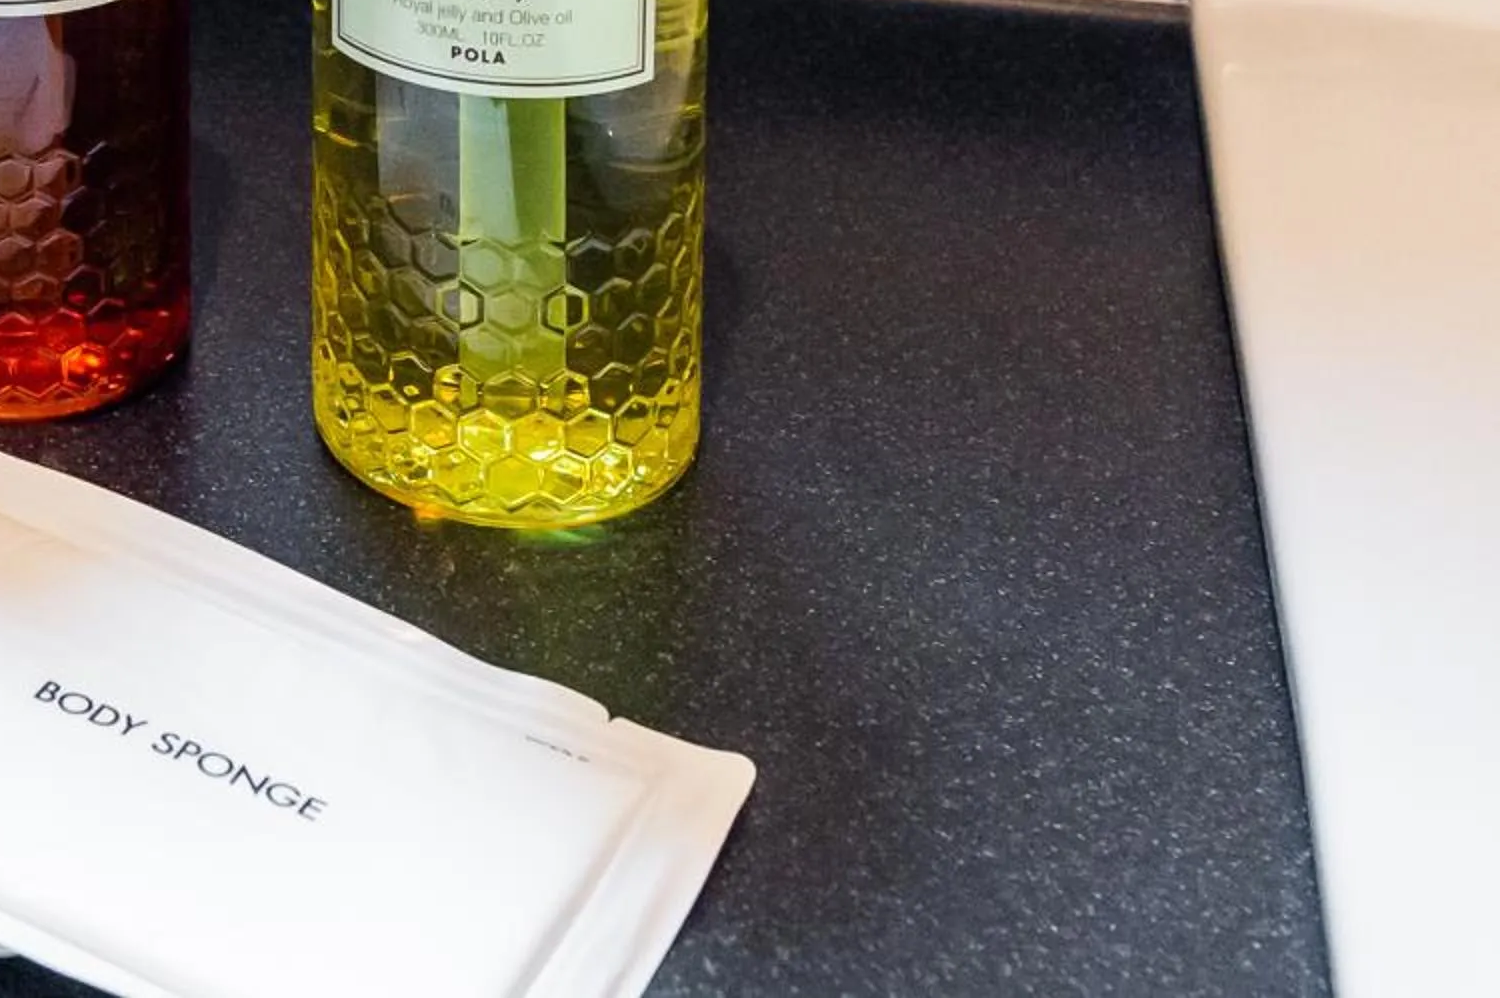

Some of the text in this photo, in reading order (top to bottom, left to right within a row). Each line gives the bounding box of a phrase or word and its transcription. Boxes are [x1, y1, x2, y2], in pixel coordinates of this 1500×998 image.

[436, 0, 467, 24] jelly
[471, 5, 503, 25] and
[508, 7, 551, 26] Olive
[555, 9, 573, 24] oil
[451, 45, 506, 65] POLA
[34, 679, 329, 822] BODY SPONGE
